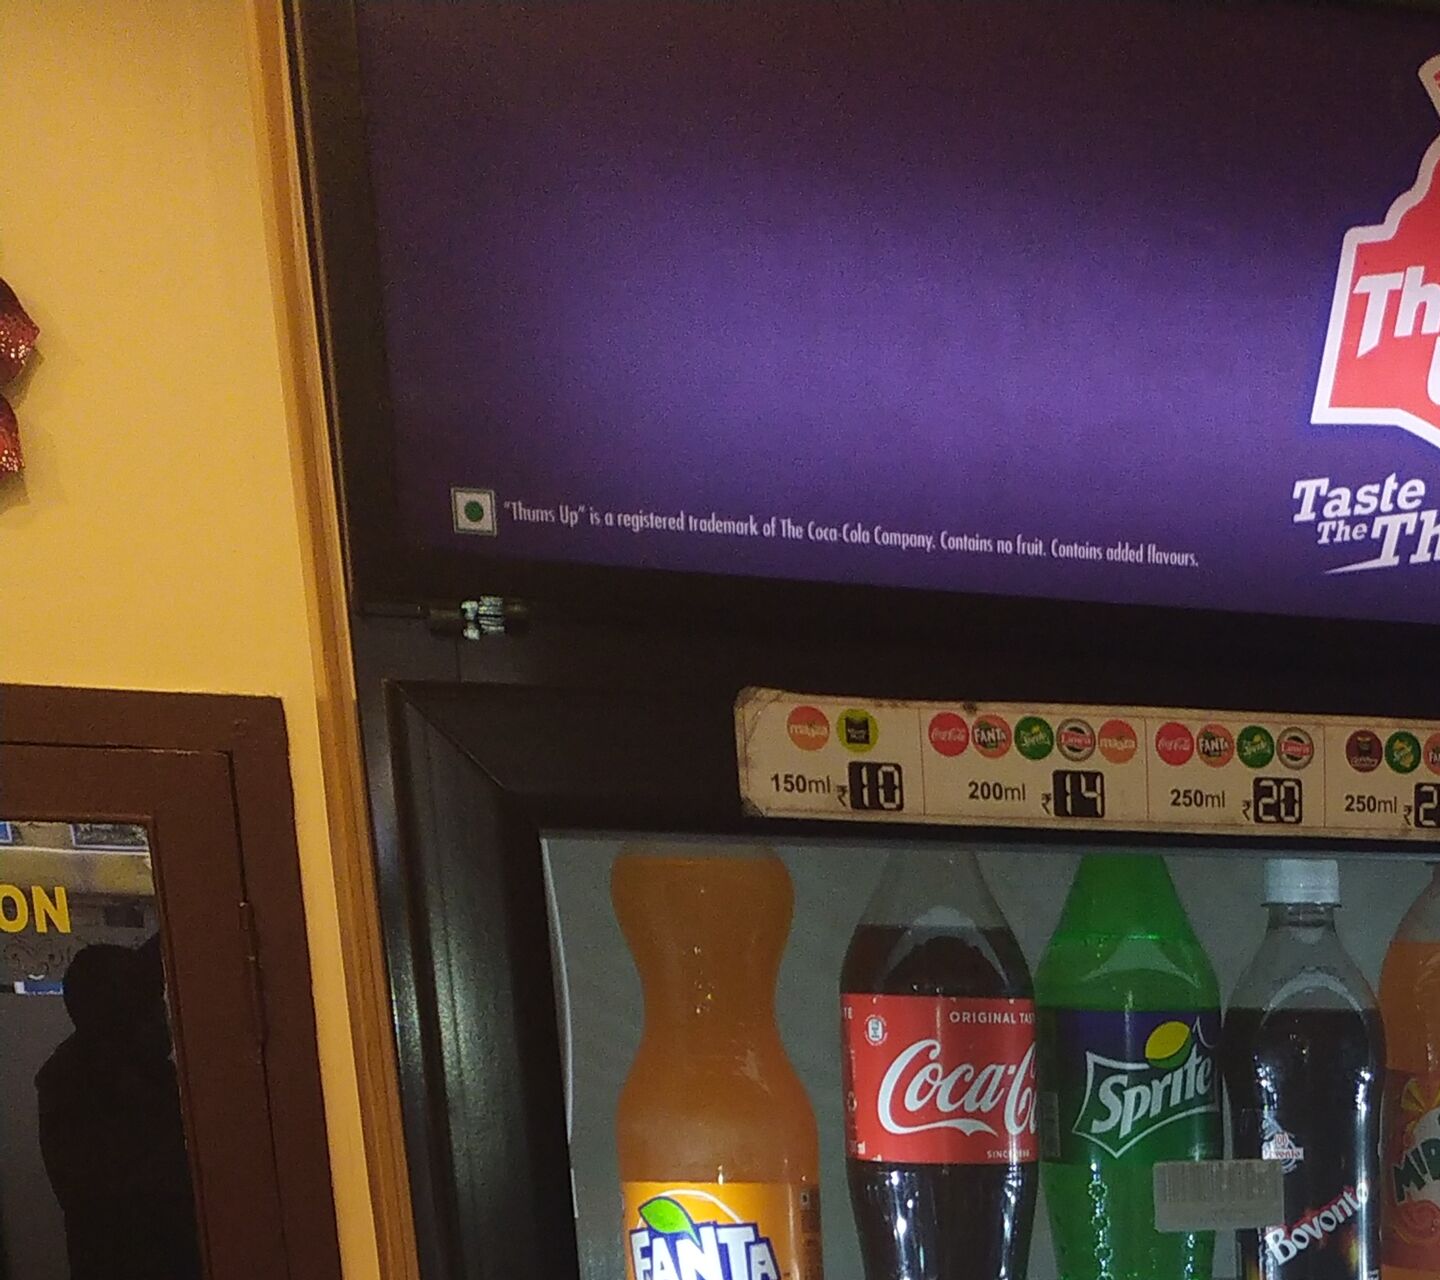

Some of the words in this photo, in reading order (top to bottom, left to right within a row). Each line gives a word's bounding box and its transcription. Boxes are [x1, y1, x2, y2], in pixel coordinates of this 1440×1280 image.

[1292, 472, 1425, 523] Taste
[590, 508, 601, 525] is
[604, 514, 614, 526] a
[617, 509, 685, 533] registered
[688, 511, 759, 537] trademark
[763, 516, 778, 537] of
[781, 518, 803, 540] The
[807, 521, 870, 544] Coca-Cola
[874, 525, 936, 552] Company.
[940, 530, 993, 553] Contains
[997, 539, 1013, 555] no
[1016, 533, 1047, 557] fruit.
[1050, 538, 1103, 561] Contains
[1106, 541, 1143, 564] added
[1147, 543, 1199, 567] flavours.
[1317, 521, 1367, 545] The
[771, 773, 831, 794] 150ml
[861, 765, 901, 809] 10
[968, 781, 1026, 801] 200ml
[1065, 773, 1102, 816] 14
[1170, 789, 1226, 808] 250ml
[1258, 779, 1300, 822] 20
[1345, 795, 1397, 814] 250ml
[950, 1011, 1016, 1024] ORIGINAL
[1091, 1045, 1212, 1139] Sprite
[1264, 1182, 1369, 1266] Bovonto
